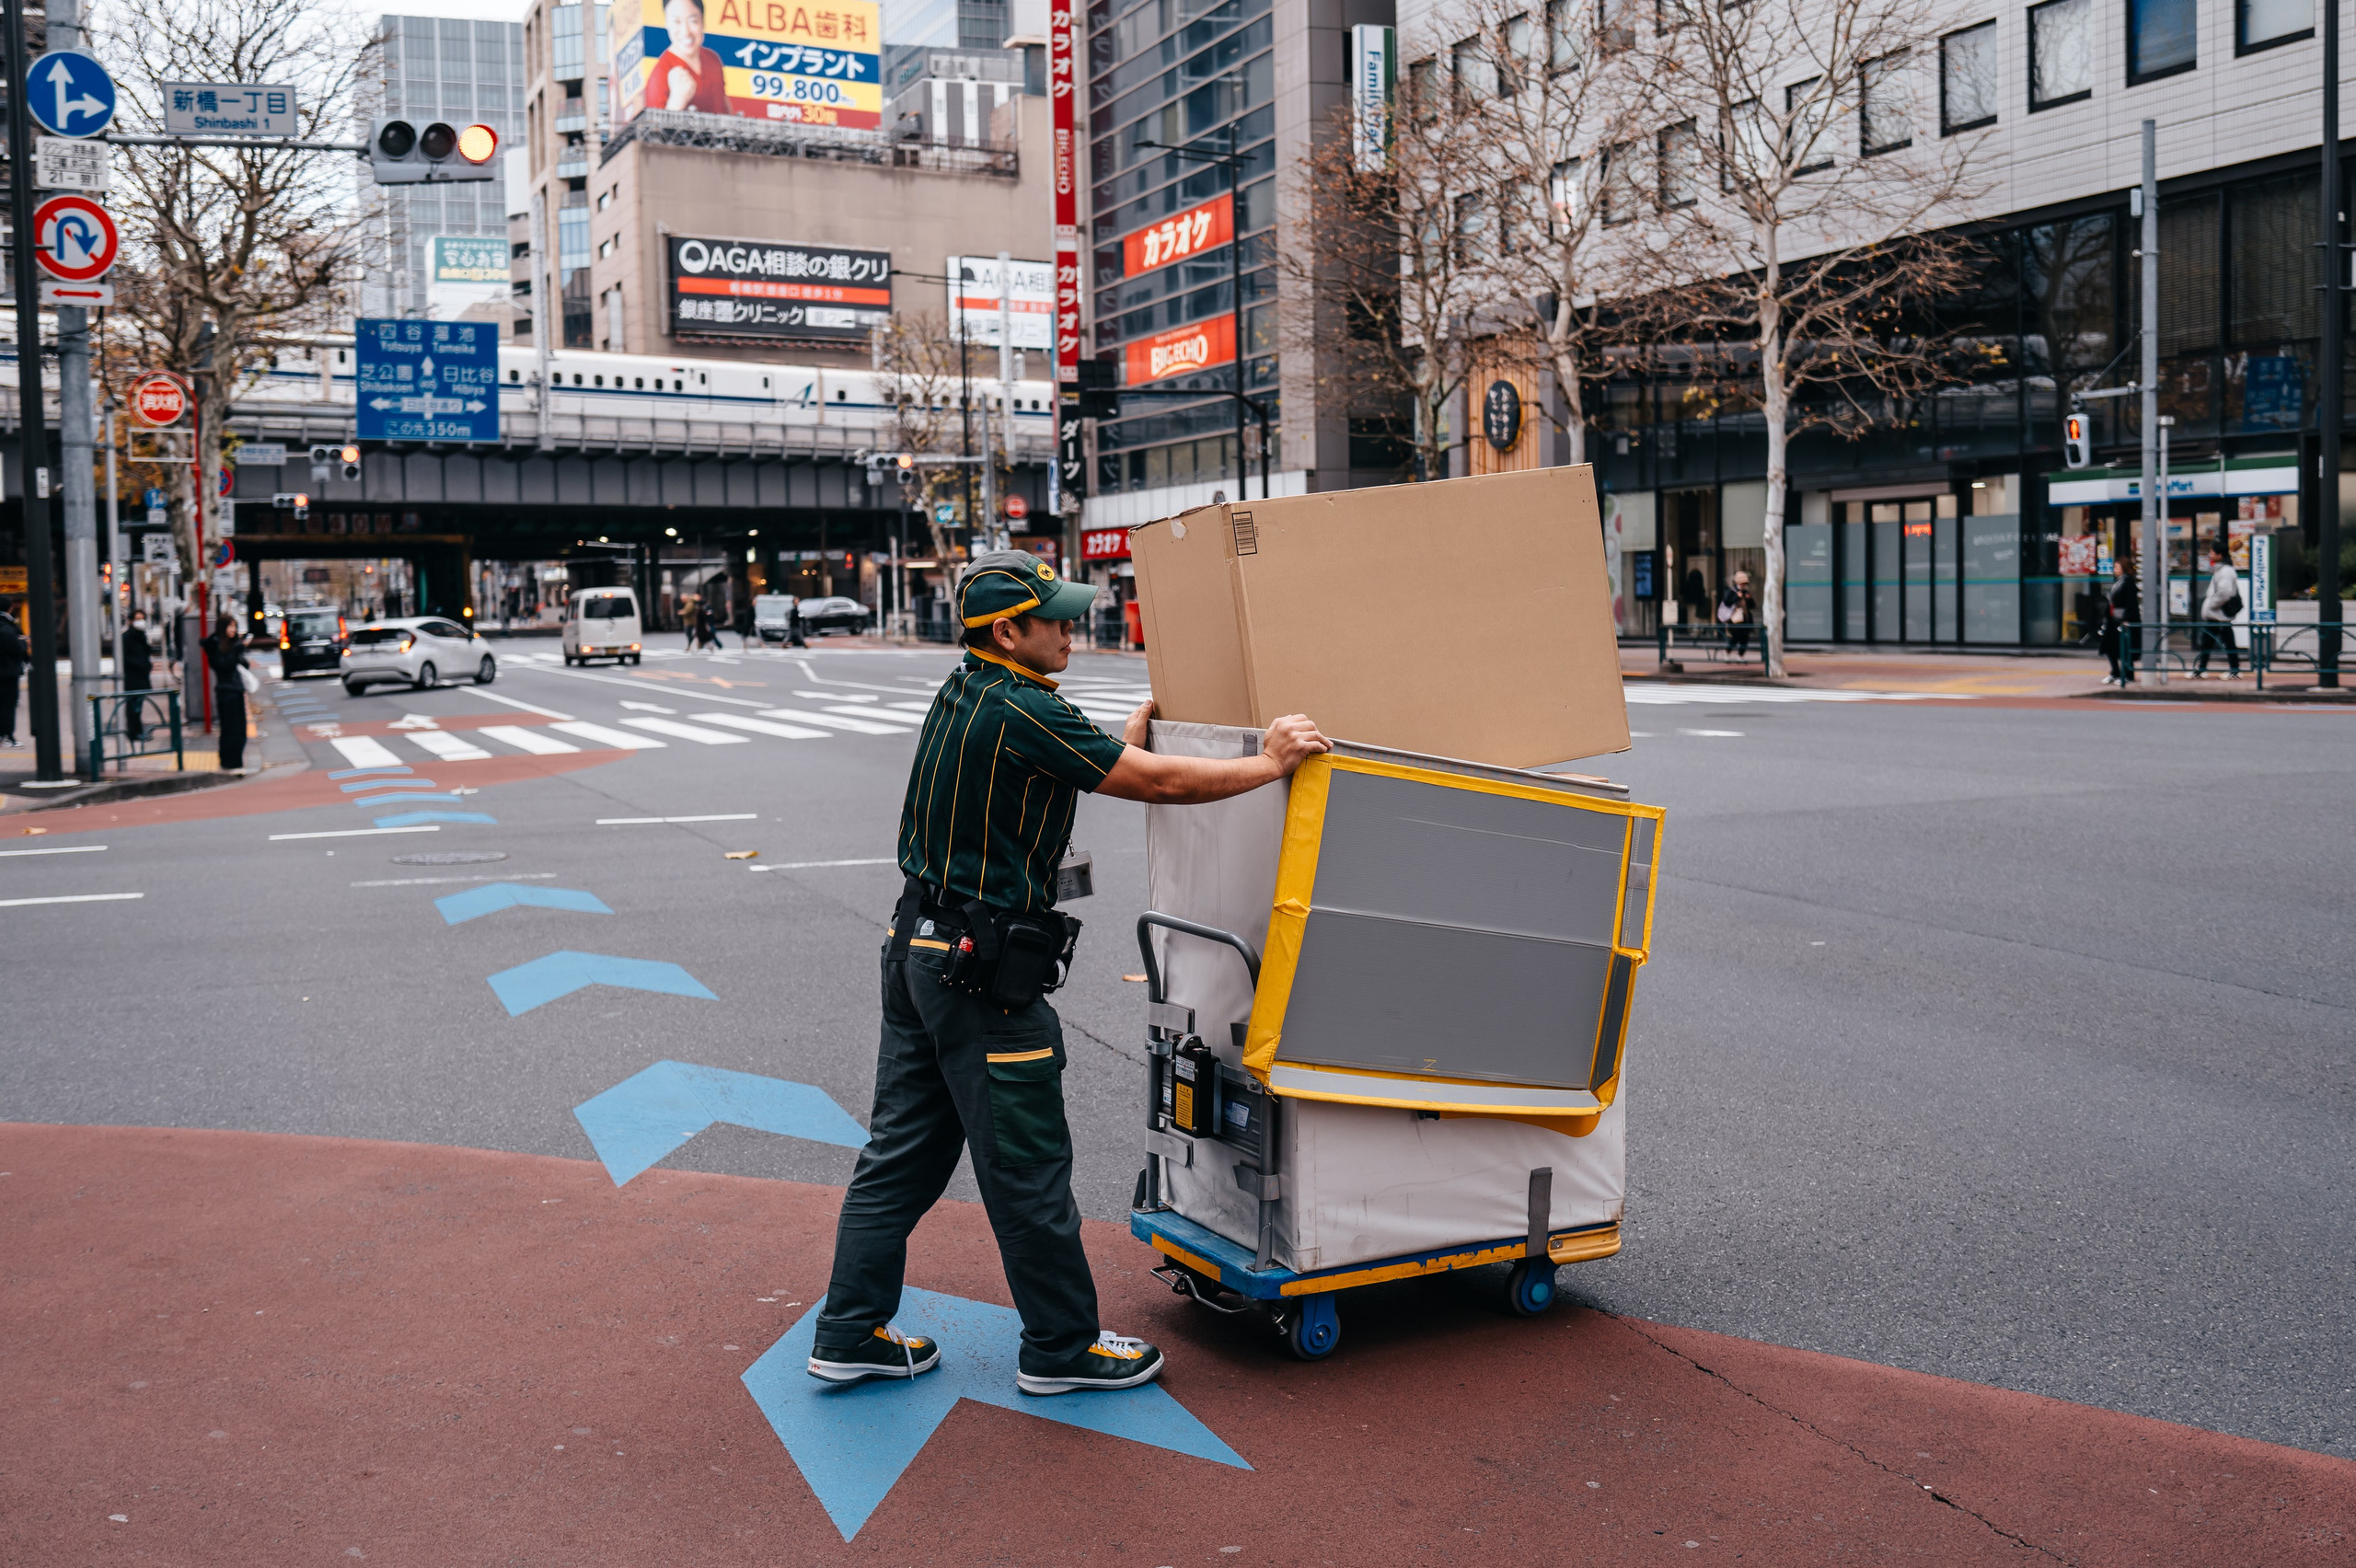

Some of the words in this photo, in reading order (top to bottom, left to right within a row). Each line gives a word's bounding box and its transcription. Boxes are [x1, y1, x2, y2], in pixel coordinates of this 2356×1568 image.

[735, 41, 865, 79] インプラント
[1053, 10, 1071, 98] カラオケ
[752, 75, 839, 103] 99,800
[173, 90, 286, 114] 新橋一丁目
[194, 116, 258, 130] Shinbashi
[263, 118, 271, 130] 1
[1143, 210, 1212, 269] カラオケ
[708, 246, 888, 282] AGA相談の銀クリ
[1058, 265, 1079, 352] カラオケ
[378, 323, 422, 341] 四谷
[433, 341, 476, 354] Tameike
[360, 363, 413, 381] 芝公園
[443, 365, 494, 384] 日比谷
[387, 421, 471, 437] この先350m
[1060, 419, 1080, 480] ダーツ
[1087, 533, 1122, 555] カラオケ
